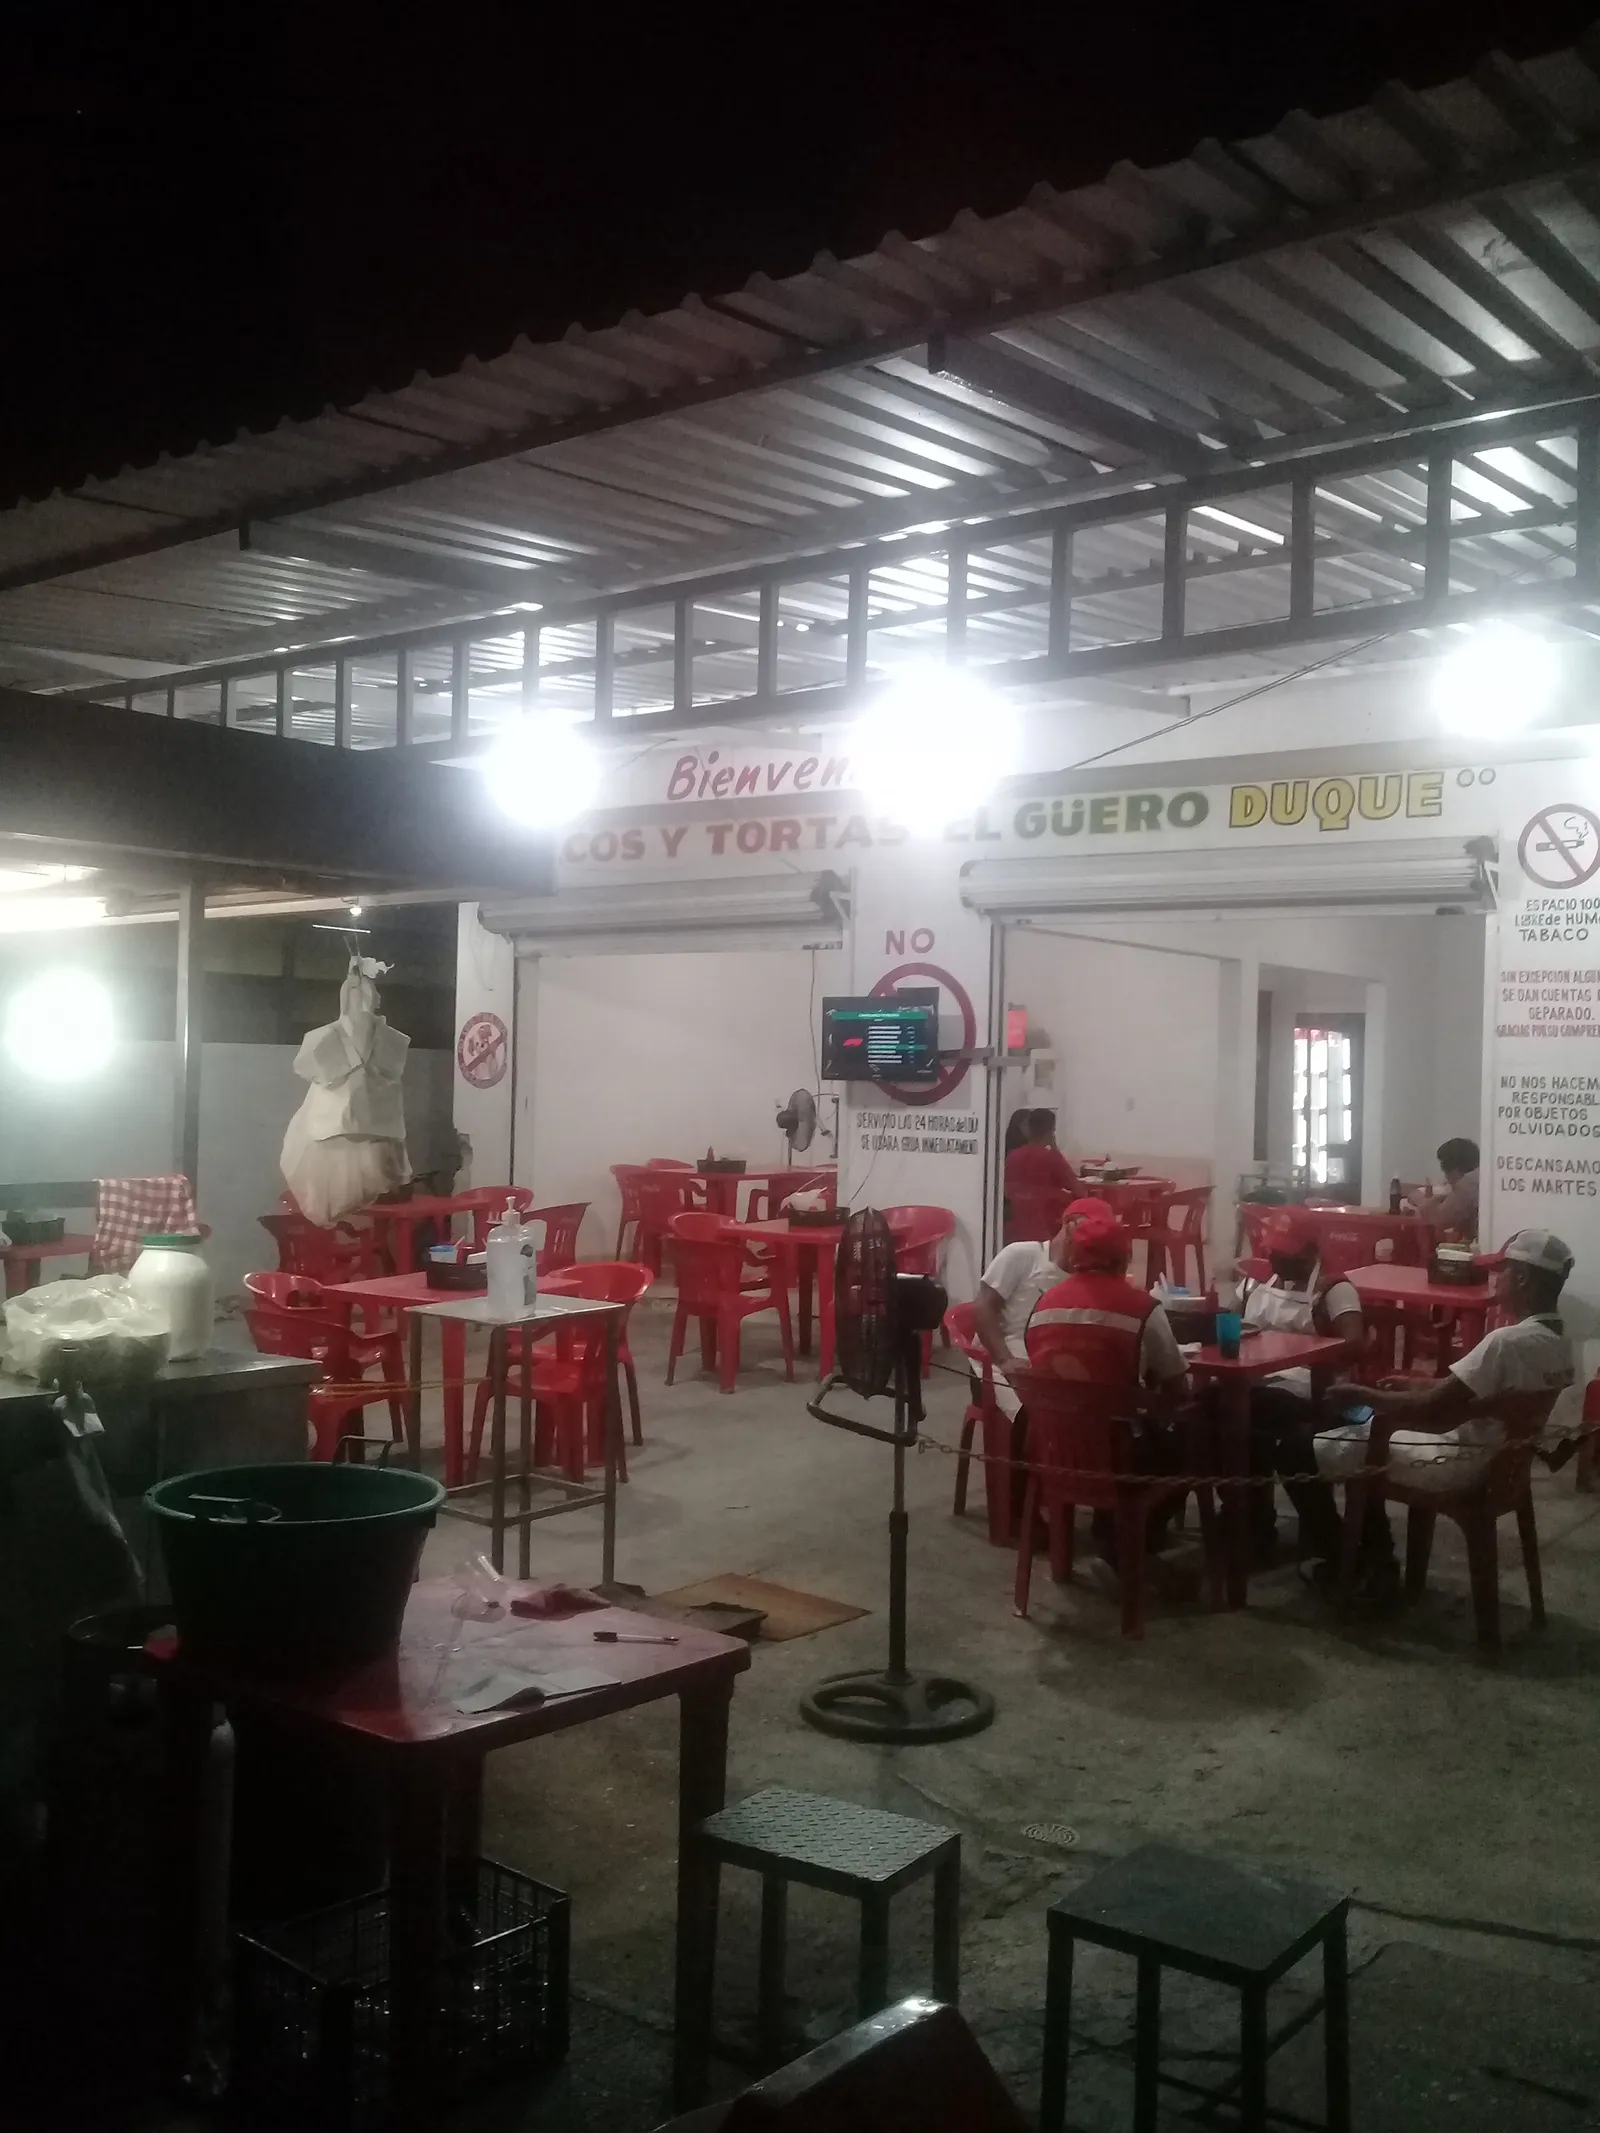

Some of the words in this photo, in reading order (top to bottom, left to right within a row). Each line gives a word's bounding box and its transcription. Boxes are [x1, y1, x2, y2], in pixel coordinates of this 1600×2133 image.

[667, 750, 854, 800] Bienven
[560, 828, 645, 863] COS
[660, 826, 689, 858] Y
[706, 815, 908, 856] TORTAS
[1013, 789, 1209, 837] GÜERO
[1229, 771, 1445, 832] DUQUE
[1525, 898, 1577, 911] ESPACIO
[1545, 914, 1561, 926] de
[1566, 912, 1600, 925] HUM
[885, 927, 935, 955] NO
[1518, 928, 1589, 941] TABACO
[1503, 988, 1515, 1002] SE
[1517, 988, 1540, 1002] DAN
[1541, 988, 1592, 1002] CUENTAS
[1528, 1006, 1596, 1020] SEPARADO.
[1500, 1076, 1516, 1089] NO
[1521, 1076, 1546, 1089] NOS
[1551, 1076, 1600, 1091] HACEM
[1498, 1106, 1521, 1119] POR
[1524, 1106, 1588, 1121] OBJETOS
[857, 1112, 896, 1129] SERVICIO
[914, 1115, 926, 1130] 24
[927, 1115, 955, 1132] HORAS
[1508, 1122, 1600, 1138] OLVIDADOS
[1501, 1178, 1526, 1192] LOS
[1531, 1178, 1597, 1197] MARTES
